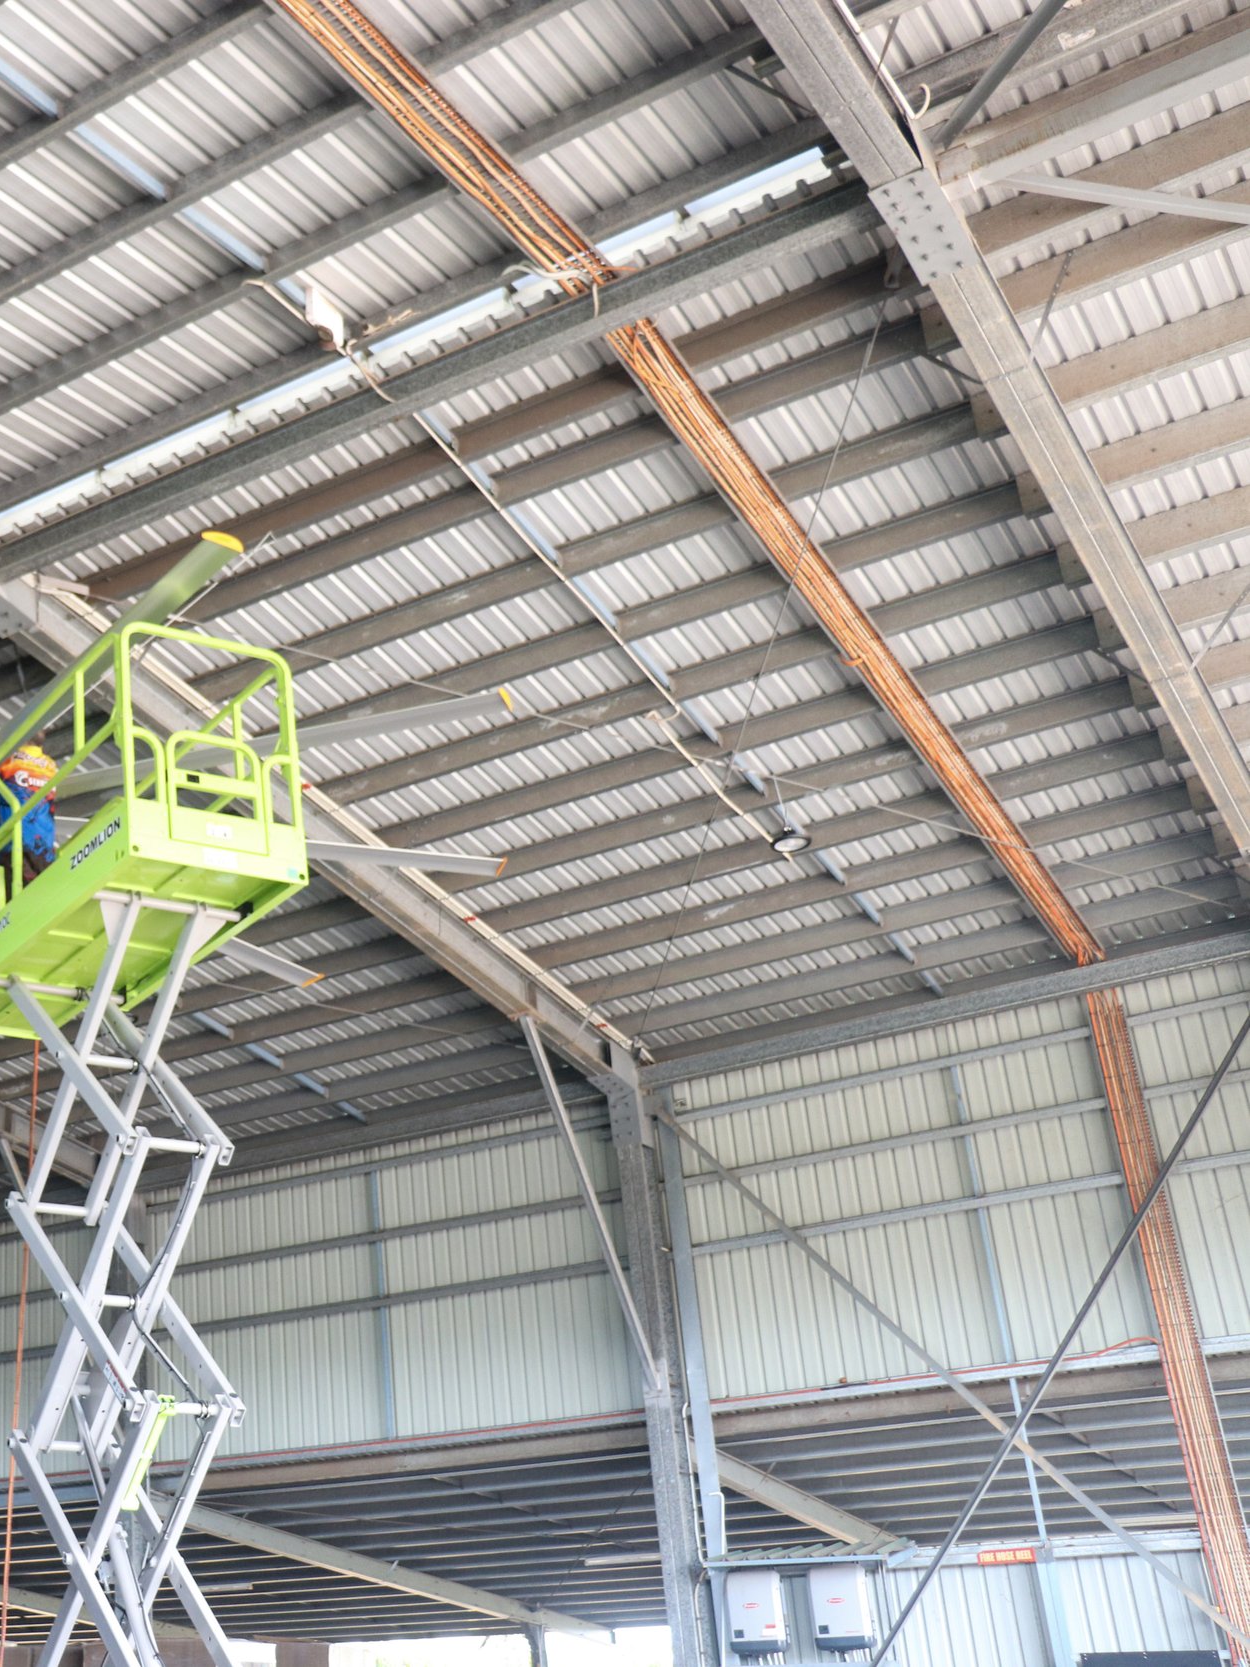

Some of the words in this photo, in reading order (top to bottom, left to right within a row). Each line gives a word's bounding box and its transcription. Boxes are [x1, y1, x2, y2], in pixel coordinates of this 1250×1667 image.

[70, 816, 120, 870] ZOOMLION
[979, 1552, 995, 1562] FIRE
[995, 1551, 1015, 1561] HOSE
[1015, 1549, 1033, 1560] REEL
